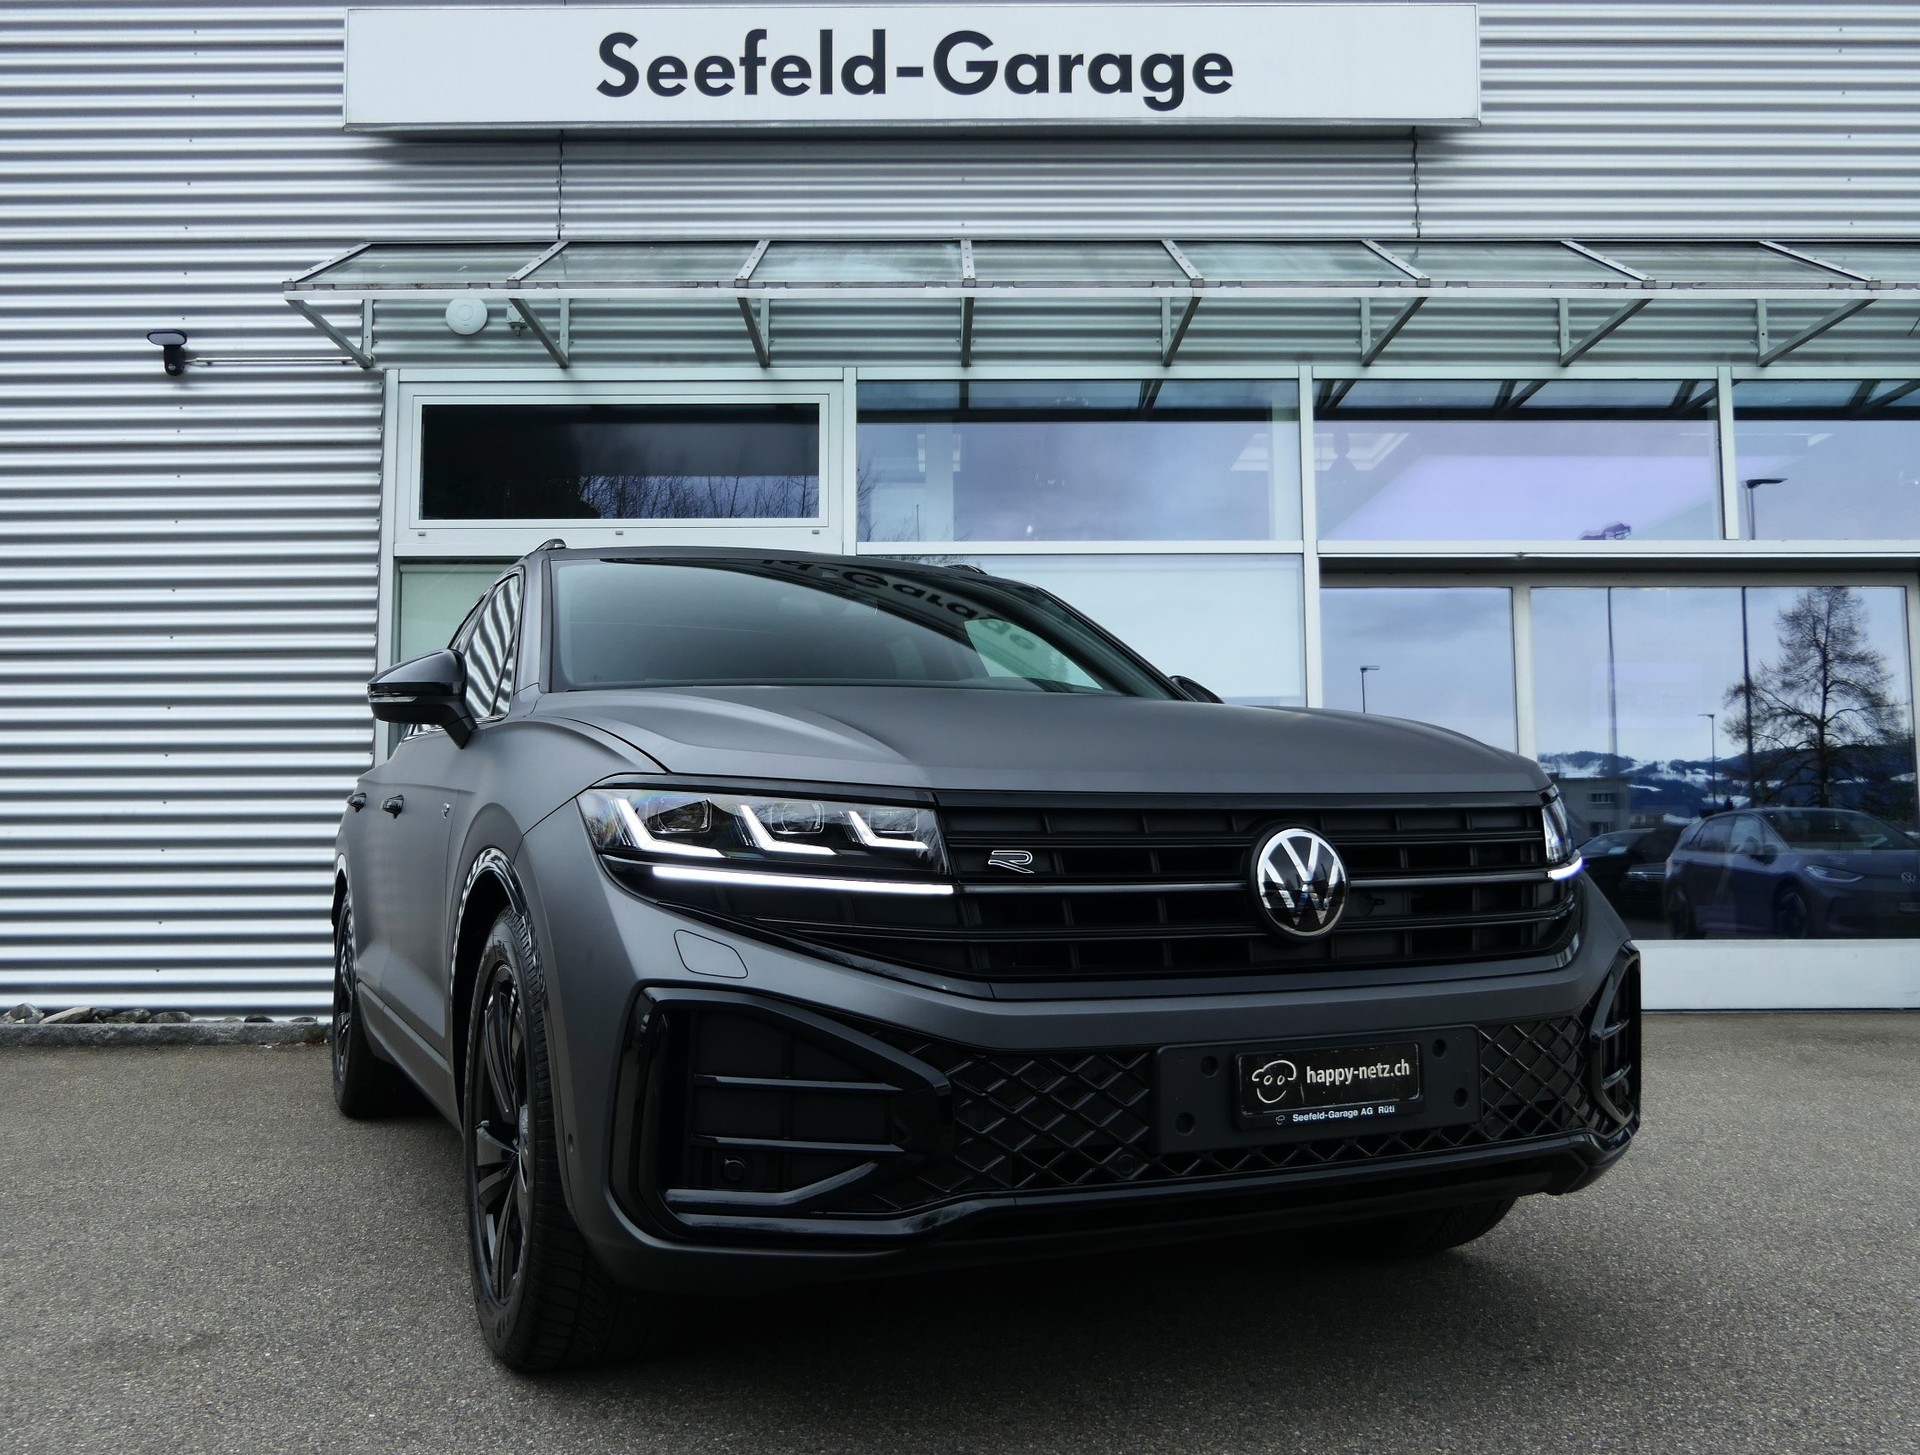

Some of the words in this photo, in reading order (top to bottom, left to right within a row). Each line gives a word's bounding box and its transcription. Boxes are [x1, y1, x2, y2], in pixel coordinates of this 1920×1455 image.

[596, 28, 1233, 112] Seefeld-Garage
[1257, 828, 1346, 936] VW
[1306, 1059, 1410, 1086] happy-netz.ch
[1292, 1109, 1359, 1122] Seefeld-Garage
[1360, 1107, 1374, 1116] AG
[1378, 1104, 1396, 1114] Rüti
